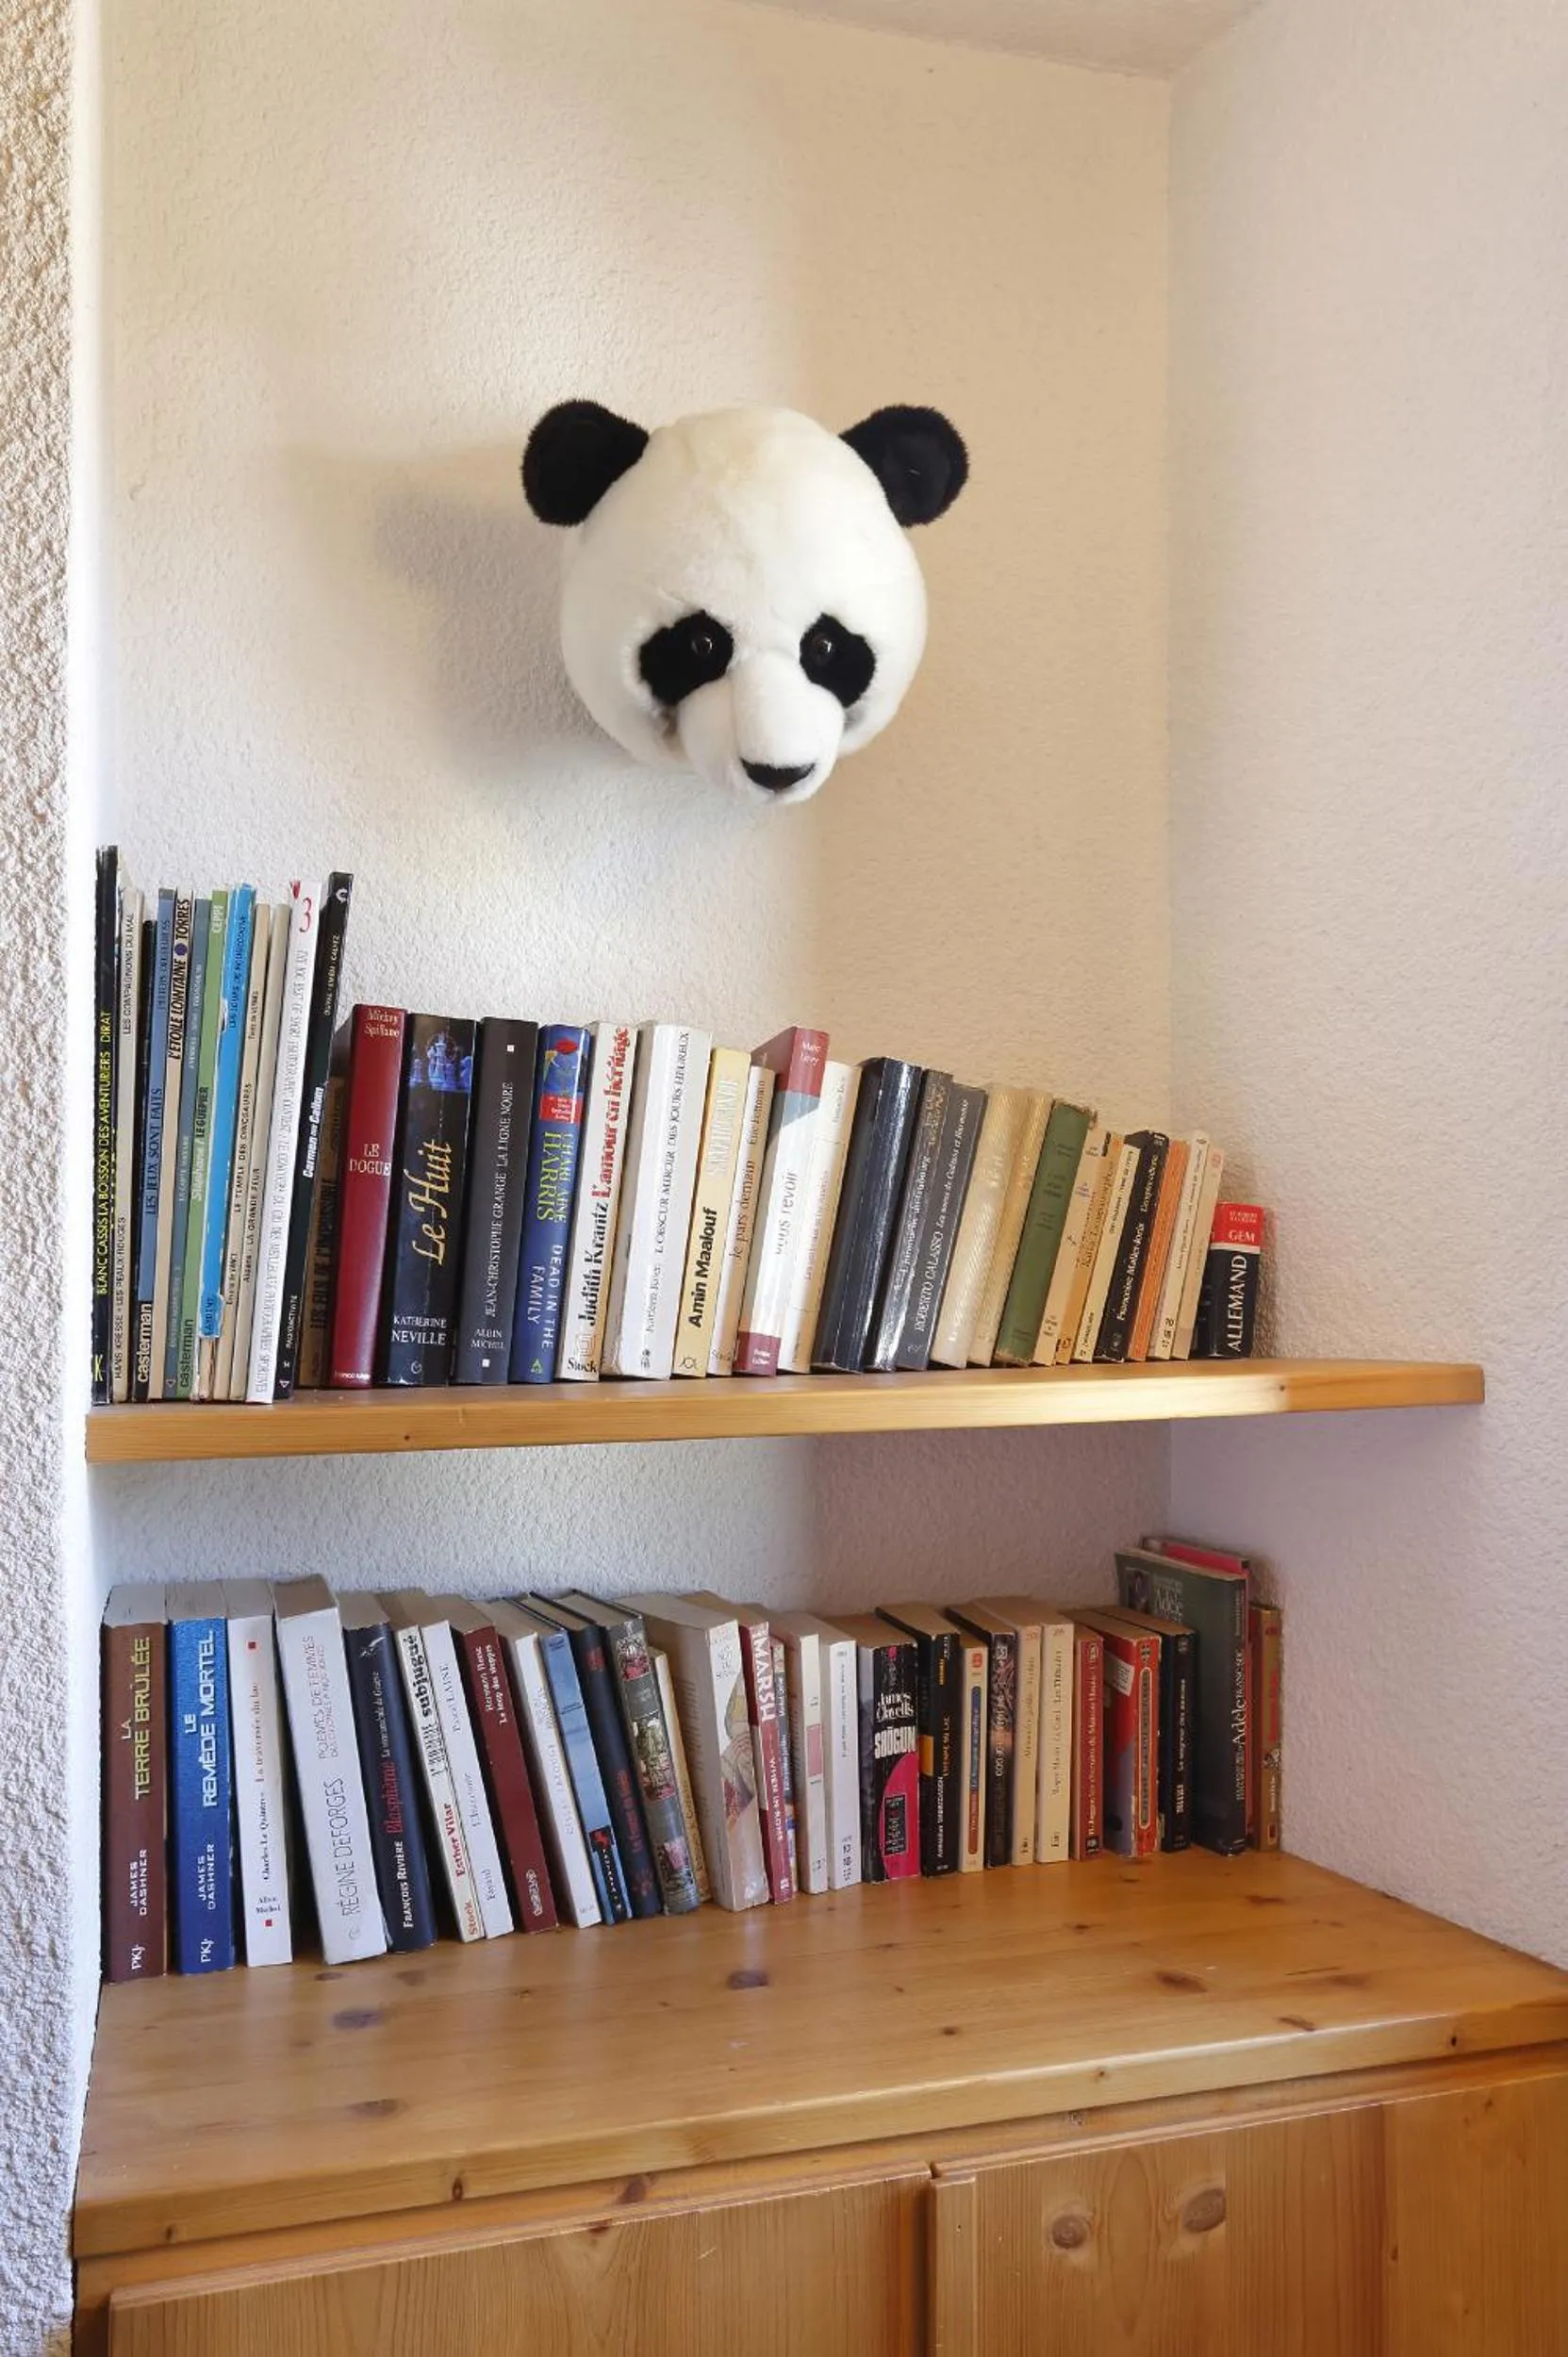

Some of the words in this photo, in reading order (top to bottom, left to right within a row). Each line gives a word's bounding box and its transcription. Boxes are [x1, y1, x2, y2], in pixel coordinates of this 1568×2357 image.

[175, 898, 190, 940] TORRES
[99, 1052, 112, 1124] AVENTURIERS
[151, 1088, 163, 1119] FAITS
[499, 1081, 514, 1115] NOIRE
[98, 1126, 110, 1146] DES
[148, 1123, 161, 1158] SONT
[303, 1137, 319, 1178] Carmen
[363, 1144, 380, 1158] LE
[496, 1118, 511, 1151] LIGNE
[97, 1150, 110, 1200] BOISSON
[146, 1162, 159, 1191] JEUX
[349, 1160, 391, 1176] DOGUE
[403, 1138, 452, 1219] Huit
[496, 1152, 507, 1167] LA
[536, 1131, 563, 1221] HARRIS
[590, 1128, 619, 1198] L'amour
[145, 1195, 157, 1215] LES
[735, 1160, 756, 1210] demain
[780, 1167, 798, 1216] revoir
[98, 1202, 109, 1216] LA
[734, 1213, 749, 1244] pars
[97, 1217, 109, 1255] CASSIS
[411, 1223, 446, 1266] Le
[585, 1201, 610, 1264] Krantz
[693, 1205, 718, 1279] Maalouf
[924, 1231, 943, 1279] CALASSO
[96, 1257, 108, 1294] BLANC
[547, 1244, 565, 1287] DEAD
[527, 1265, 546, 1324] FAMILY
[544, 1294, 559, 1312] IN
[576, 1266, 602, 1327] Judith
[686, 1281, 707, 1328] Amin
[1227, 1255, 1246, 1353] ALLEMAND
[137, 1304, 152, 1383] casterman
[390, 1330, 447, 1345] NEVILLE
[392, 1315, 448, 1328] KATHERINE
[541, 1318, 556, 1349] THE
[179, 1320, 194, 1388] casterman
[567, 1358, 596, 1373] Stock
[129, 1637, 151, 1722] BRÛLÉE
[198, 1630, 216, 1716] MORTEL
[403, 1634, 435, 1718] subjugué
[752, 1635, 776, 1722] MARSH
[121, 1719, 131, 1739] LA
[184, 1713, 197, 1734] LE
[133, 1728, 151, 1800] TERRE
[198, 1722, 218, 1807] REMÈDE
[322, 1777, 351, 1858] DEFORGES
[379, 1760, 403, 1834] Blasphème
[443, 1802, 460, 1837] Vilar
[197, 1855, 206, 1901] JAMES
[206, 1843, 216, 1910] DASHNER
[450, 1838, 468, 1878] Esther
[129, 1860, 139, 1906] JAMES
[139, 1849, 148, 1916] DASHNER
[336, 1861, 362, 1917] RÉGINE
[463, 1900, 479, 1937] Stock
